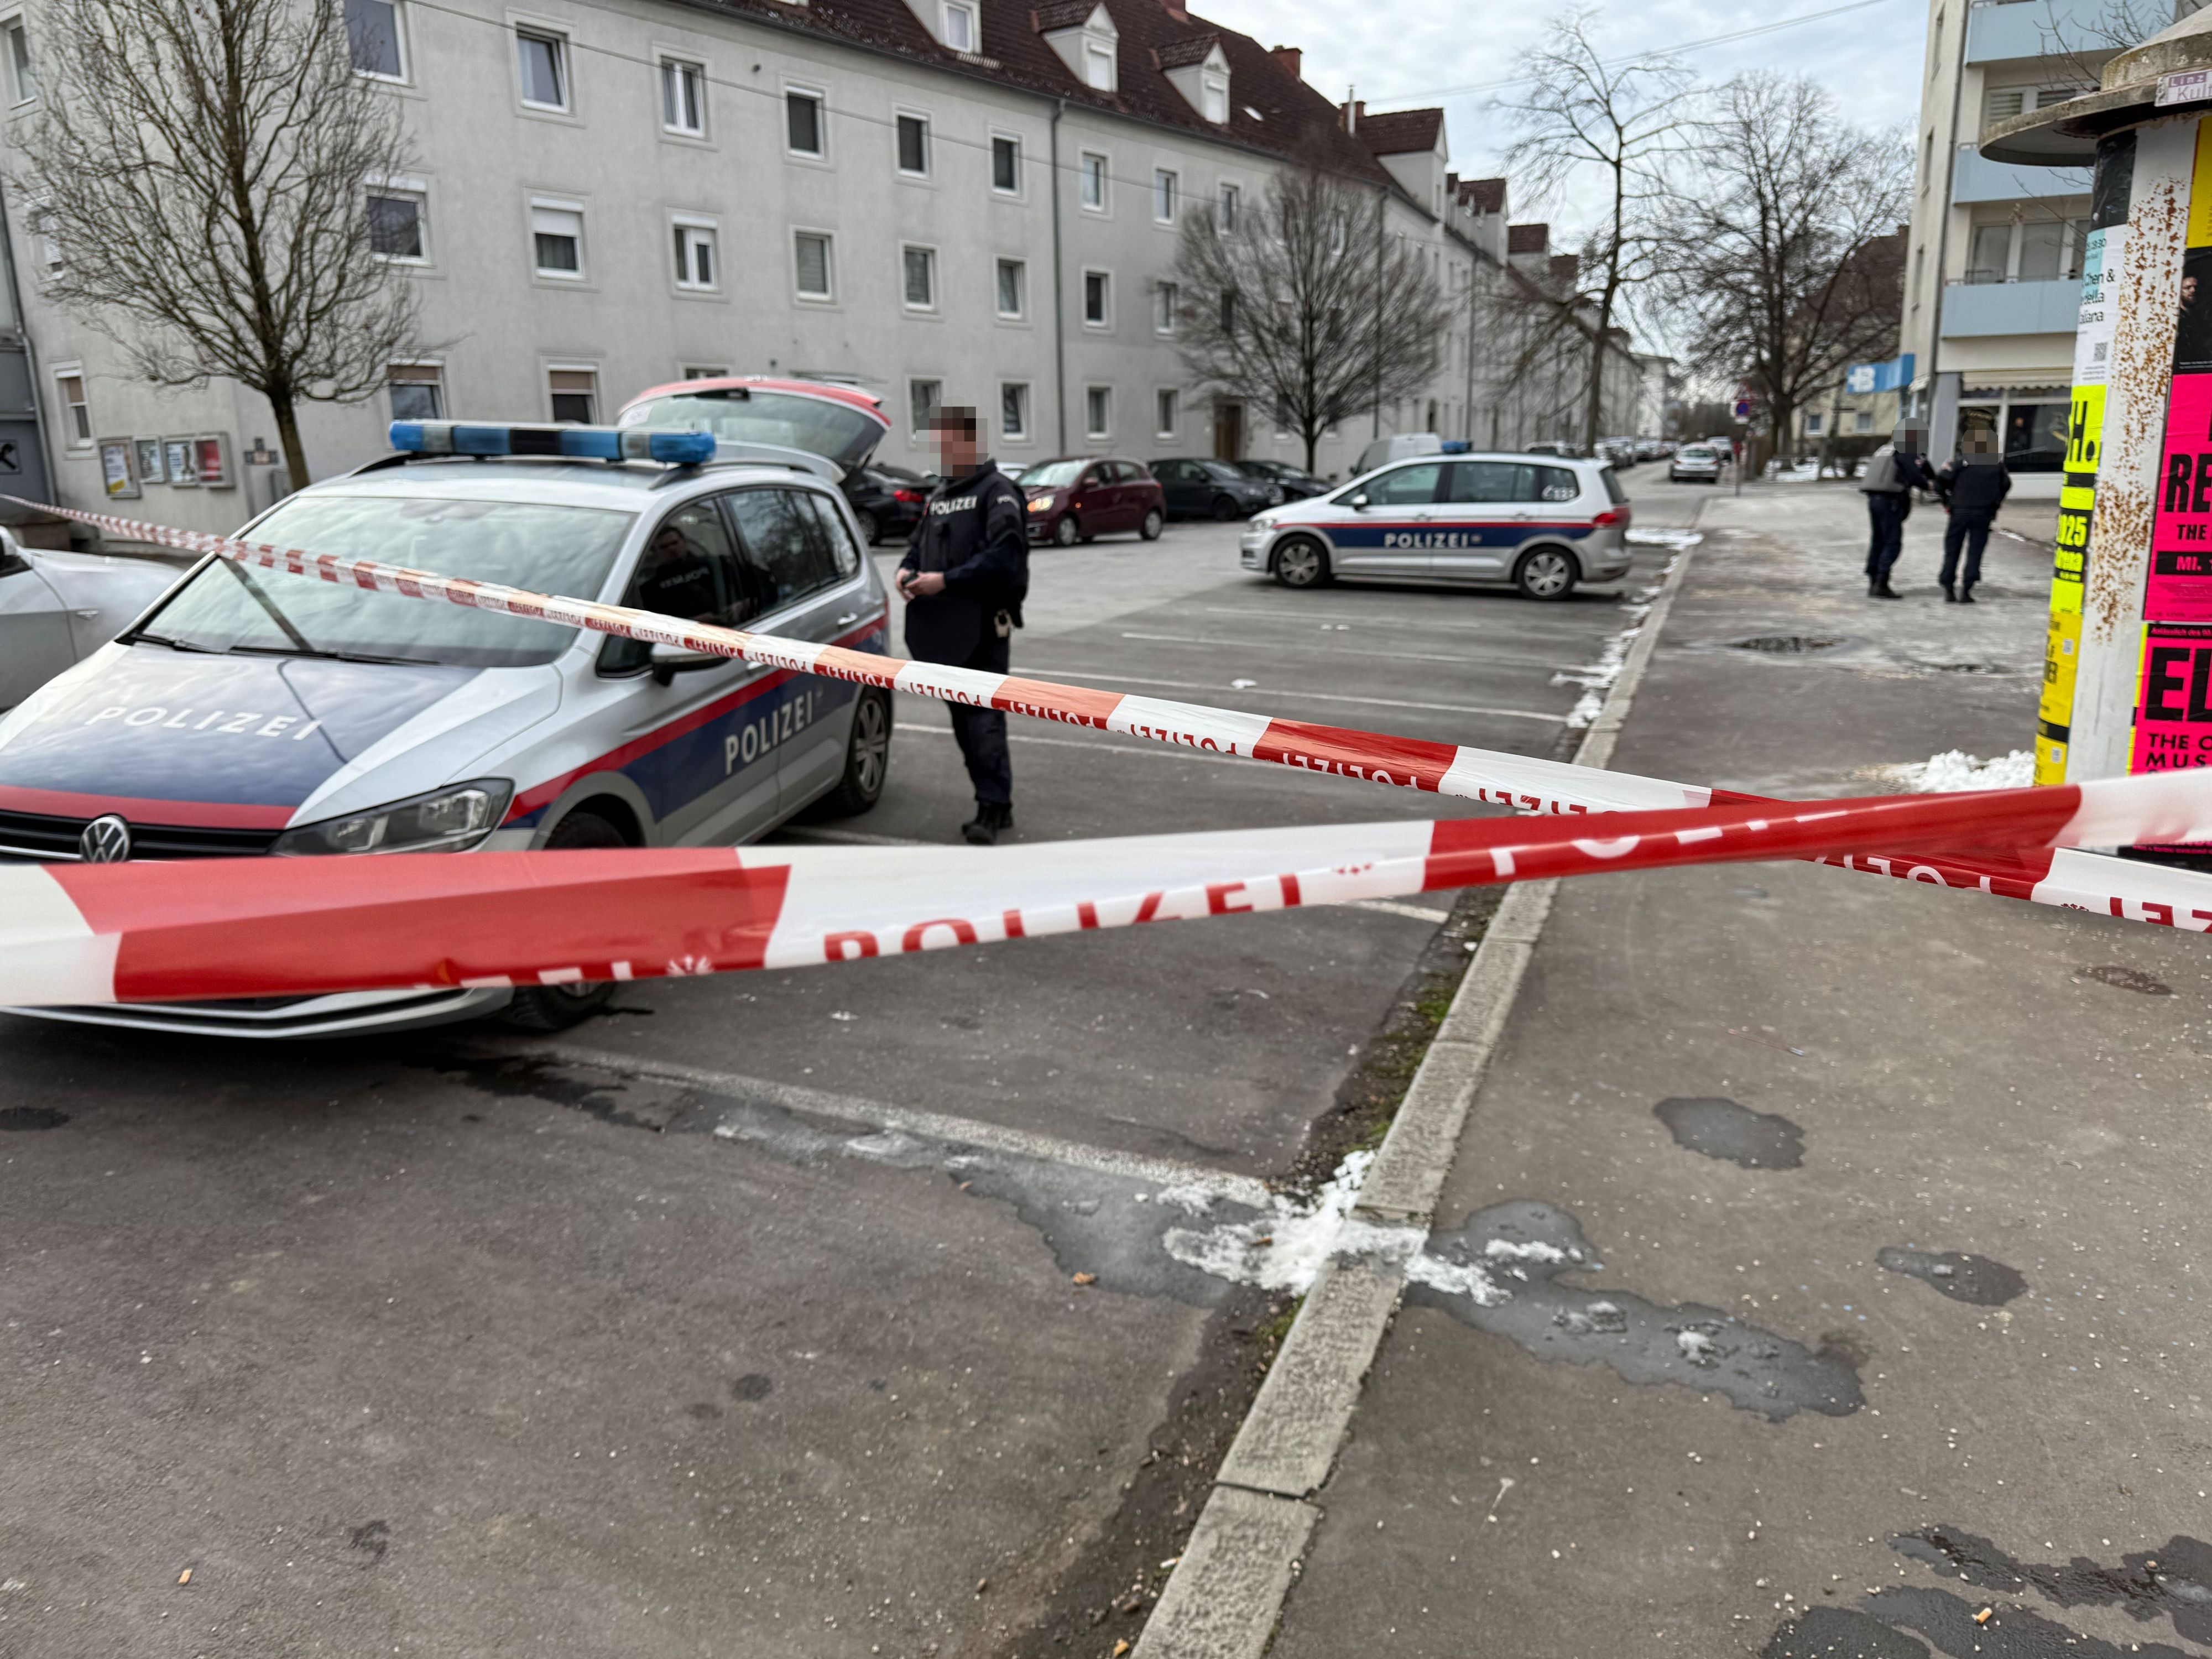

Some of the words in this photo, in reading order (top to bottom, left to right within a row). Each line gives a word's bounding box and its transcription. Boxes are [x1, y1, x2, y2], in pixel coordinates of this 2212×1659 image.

[2171, 75, 2204, 86] Linz
[2106, 268, 2115, 283] &
[2177, 524, 2207, 540] THE
[1384, 533, 1469, 549] POLIZEI
[84, 706, 322, 740] POLIZEI
[725, 690, 812, 775] POLIZEI
[2147, 734, 2189, 750] THE
